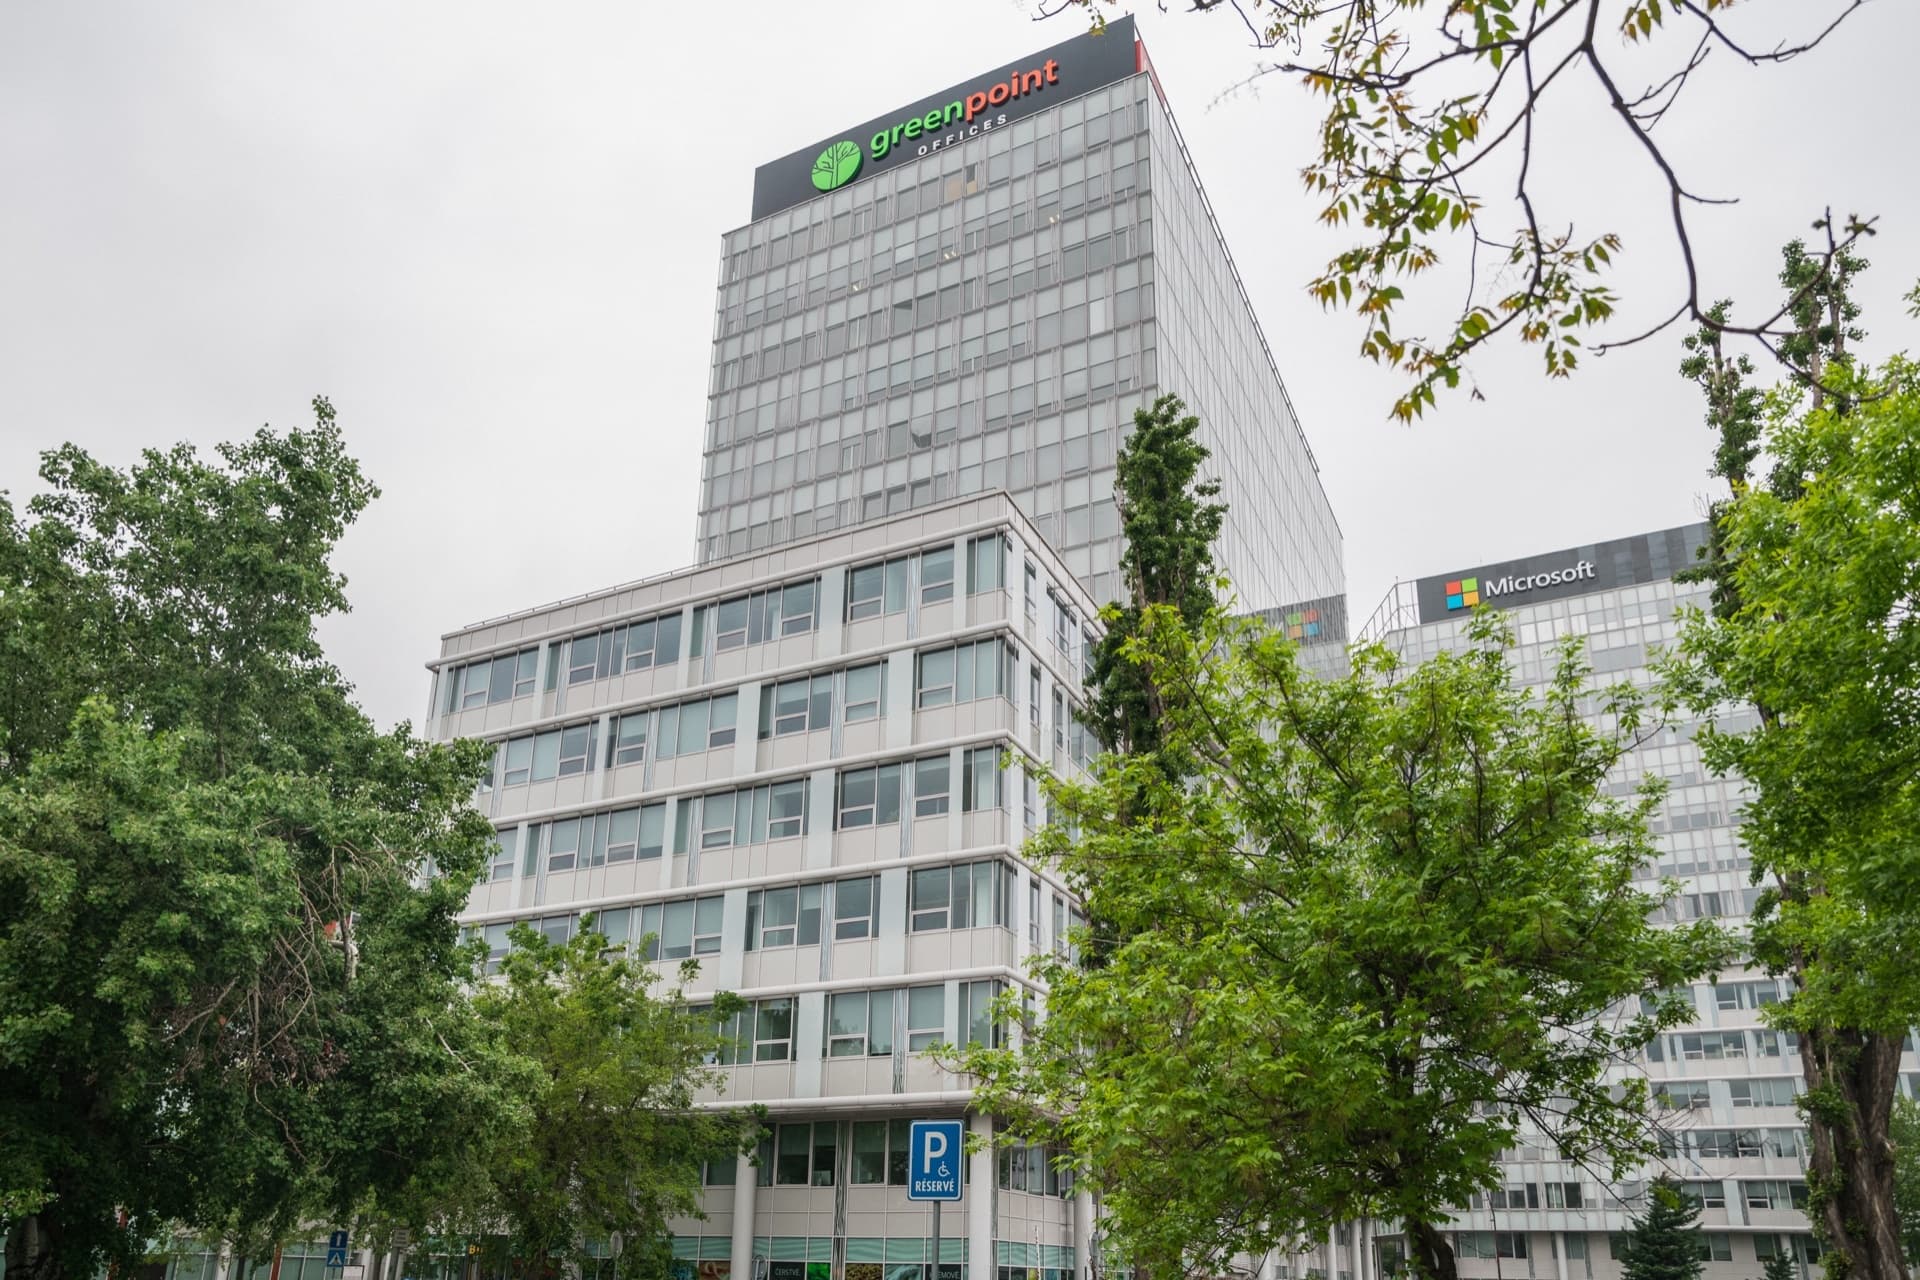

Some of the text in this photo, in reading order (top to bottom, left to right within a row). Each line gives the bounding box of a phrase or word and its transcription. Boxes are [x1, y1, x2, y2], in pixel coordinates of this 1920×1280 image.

[870, 59, 1058, 159] greenpoint
[918, 114, 1007, 155] OFFICES
[1485, 560, 1595, 597] Microsoft
[924, 1131, 947, 1174] P
[915, 1178, 954, 1192] RÉSERVÉ
